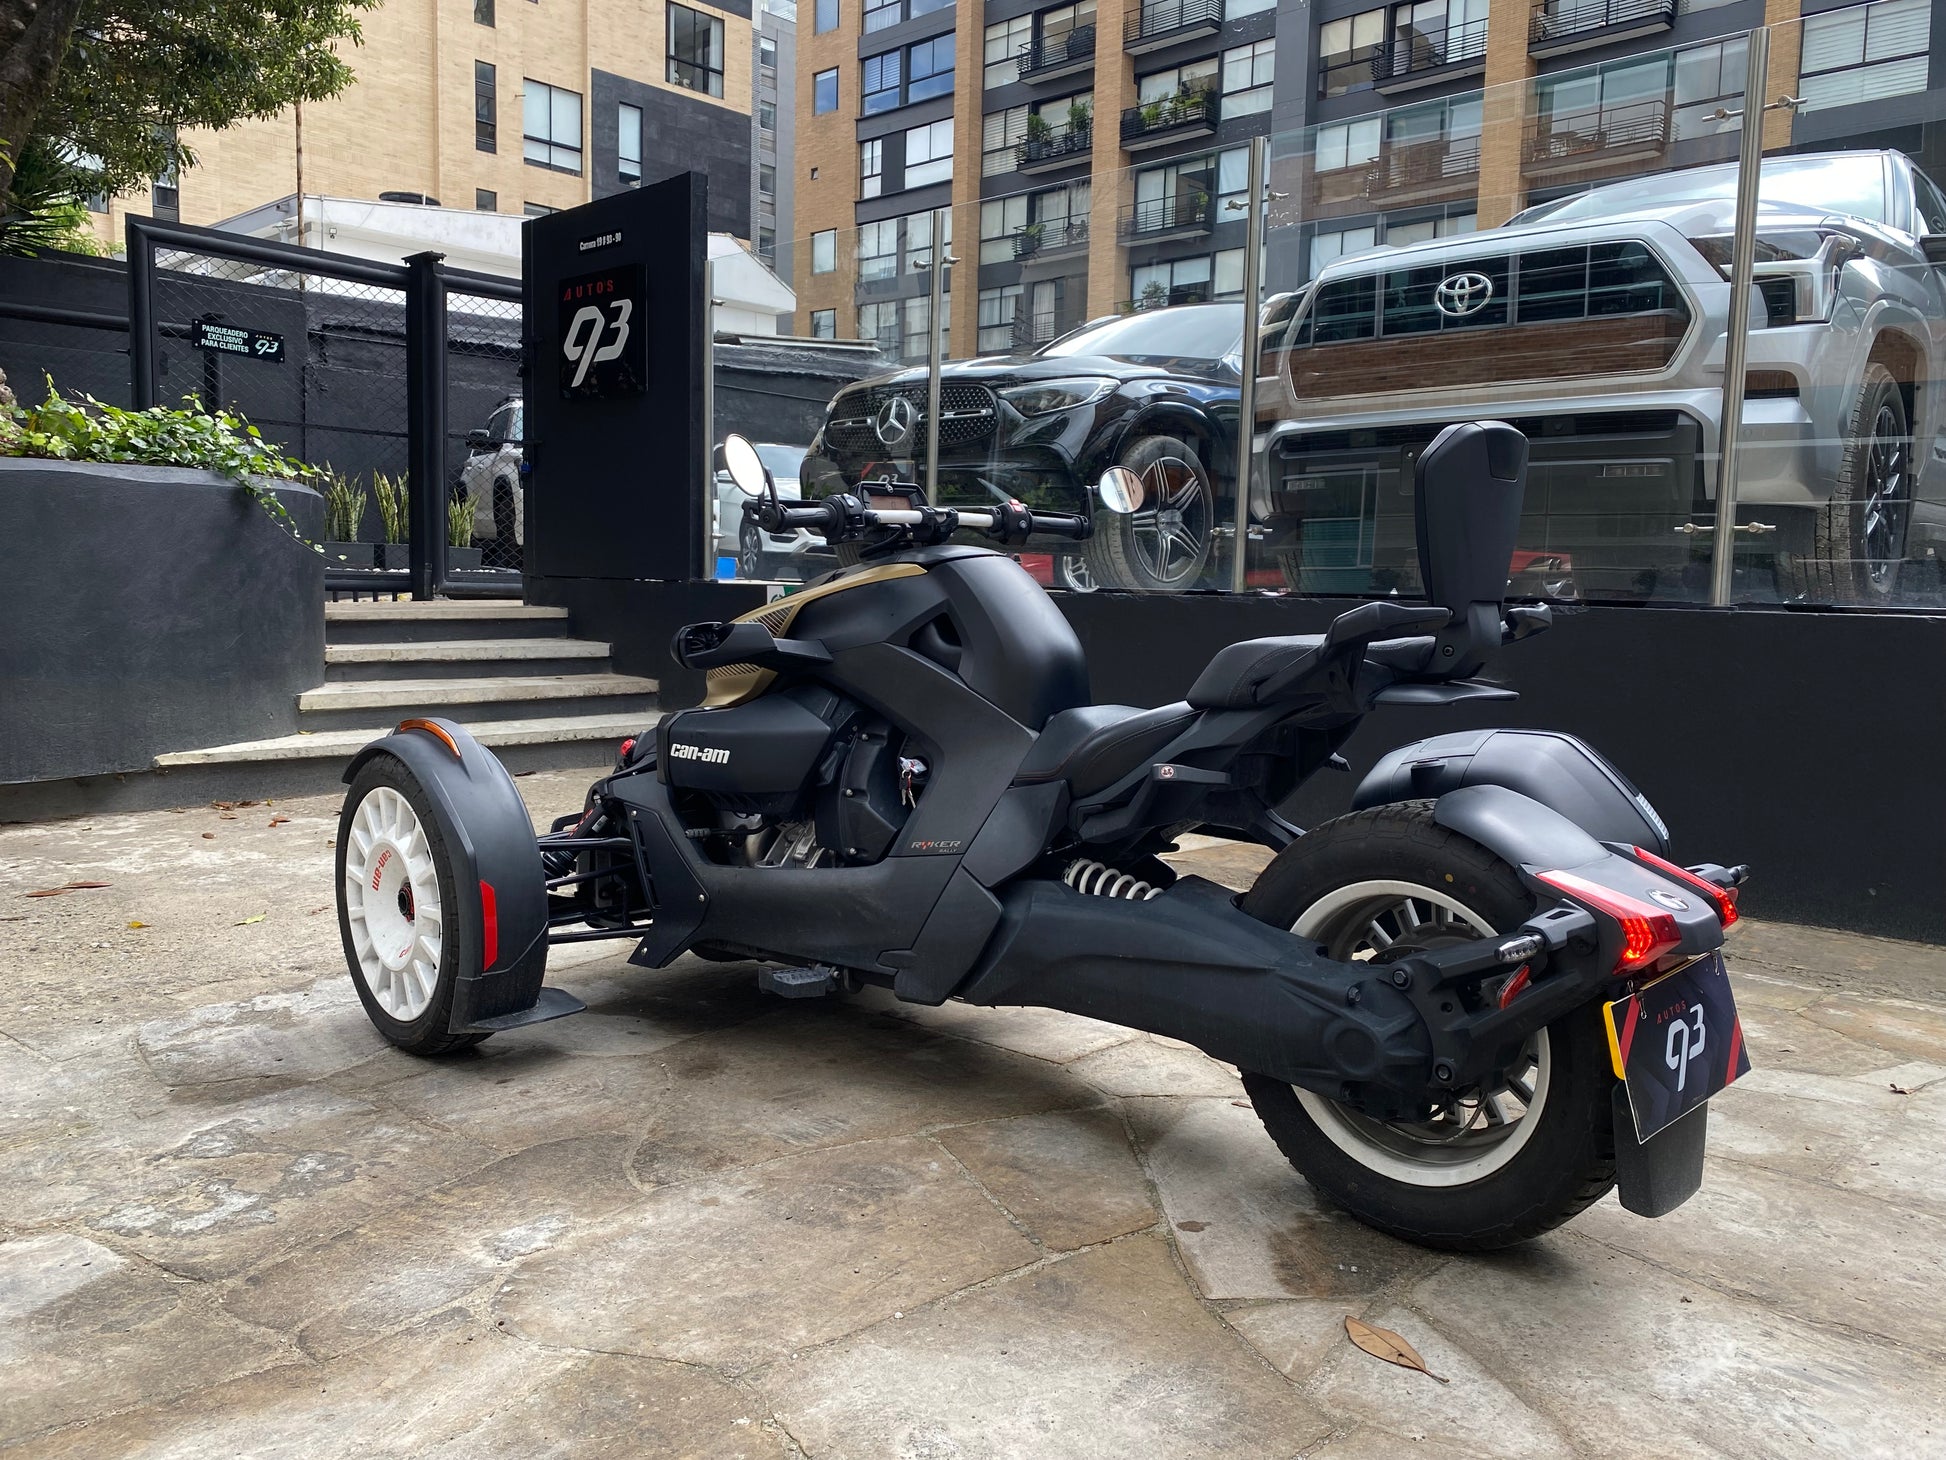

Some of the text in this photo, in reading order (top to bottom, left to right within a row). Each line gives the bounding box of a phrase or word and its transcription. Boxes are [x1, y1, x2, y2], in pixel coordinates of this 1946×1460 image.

[563, 279, 614, 301] AUTOS
[202, 324, 248, 339] PARQUEADERO
[208, 333, 243, 345] EXCLUSIVO
[201, 338, 249, 353] PARA CLIENTES
[255, 339, 279, 355] 93
[563, 298, 632, 387] 93
[670, 743, 730, 764] can-am
[911, 840, 961, 850] RYKER
[372, 849, 392, 891] can-am
[1656, 1000, 1687, 1024] AUTOS
[1665, 1003, 1706, 1092] 93
